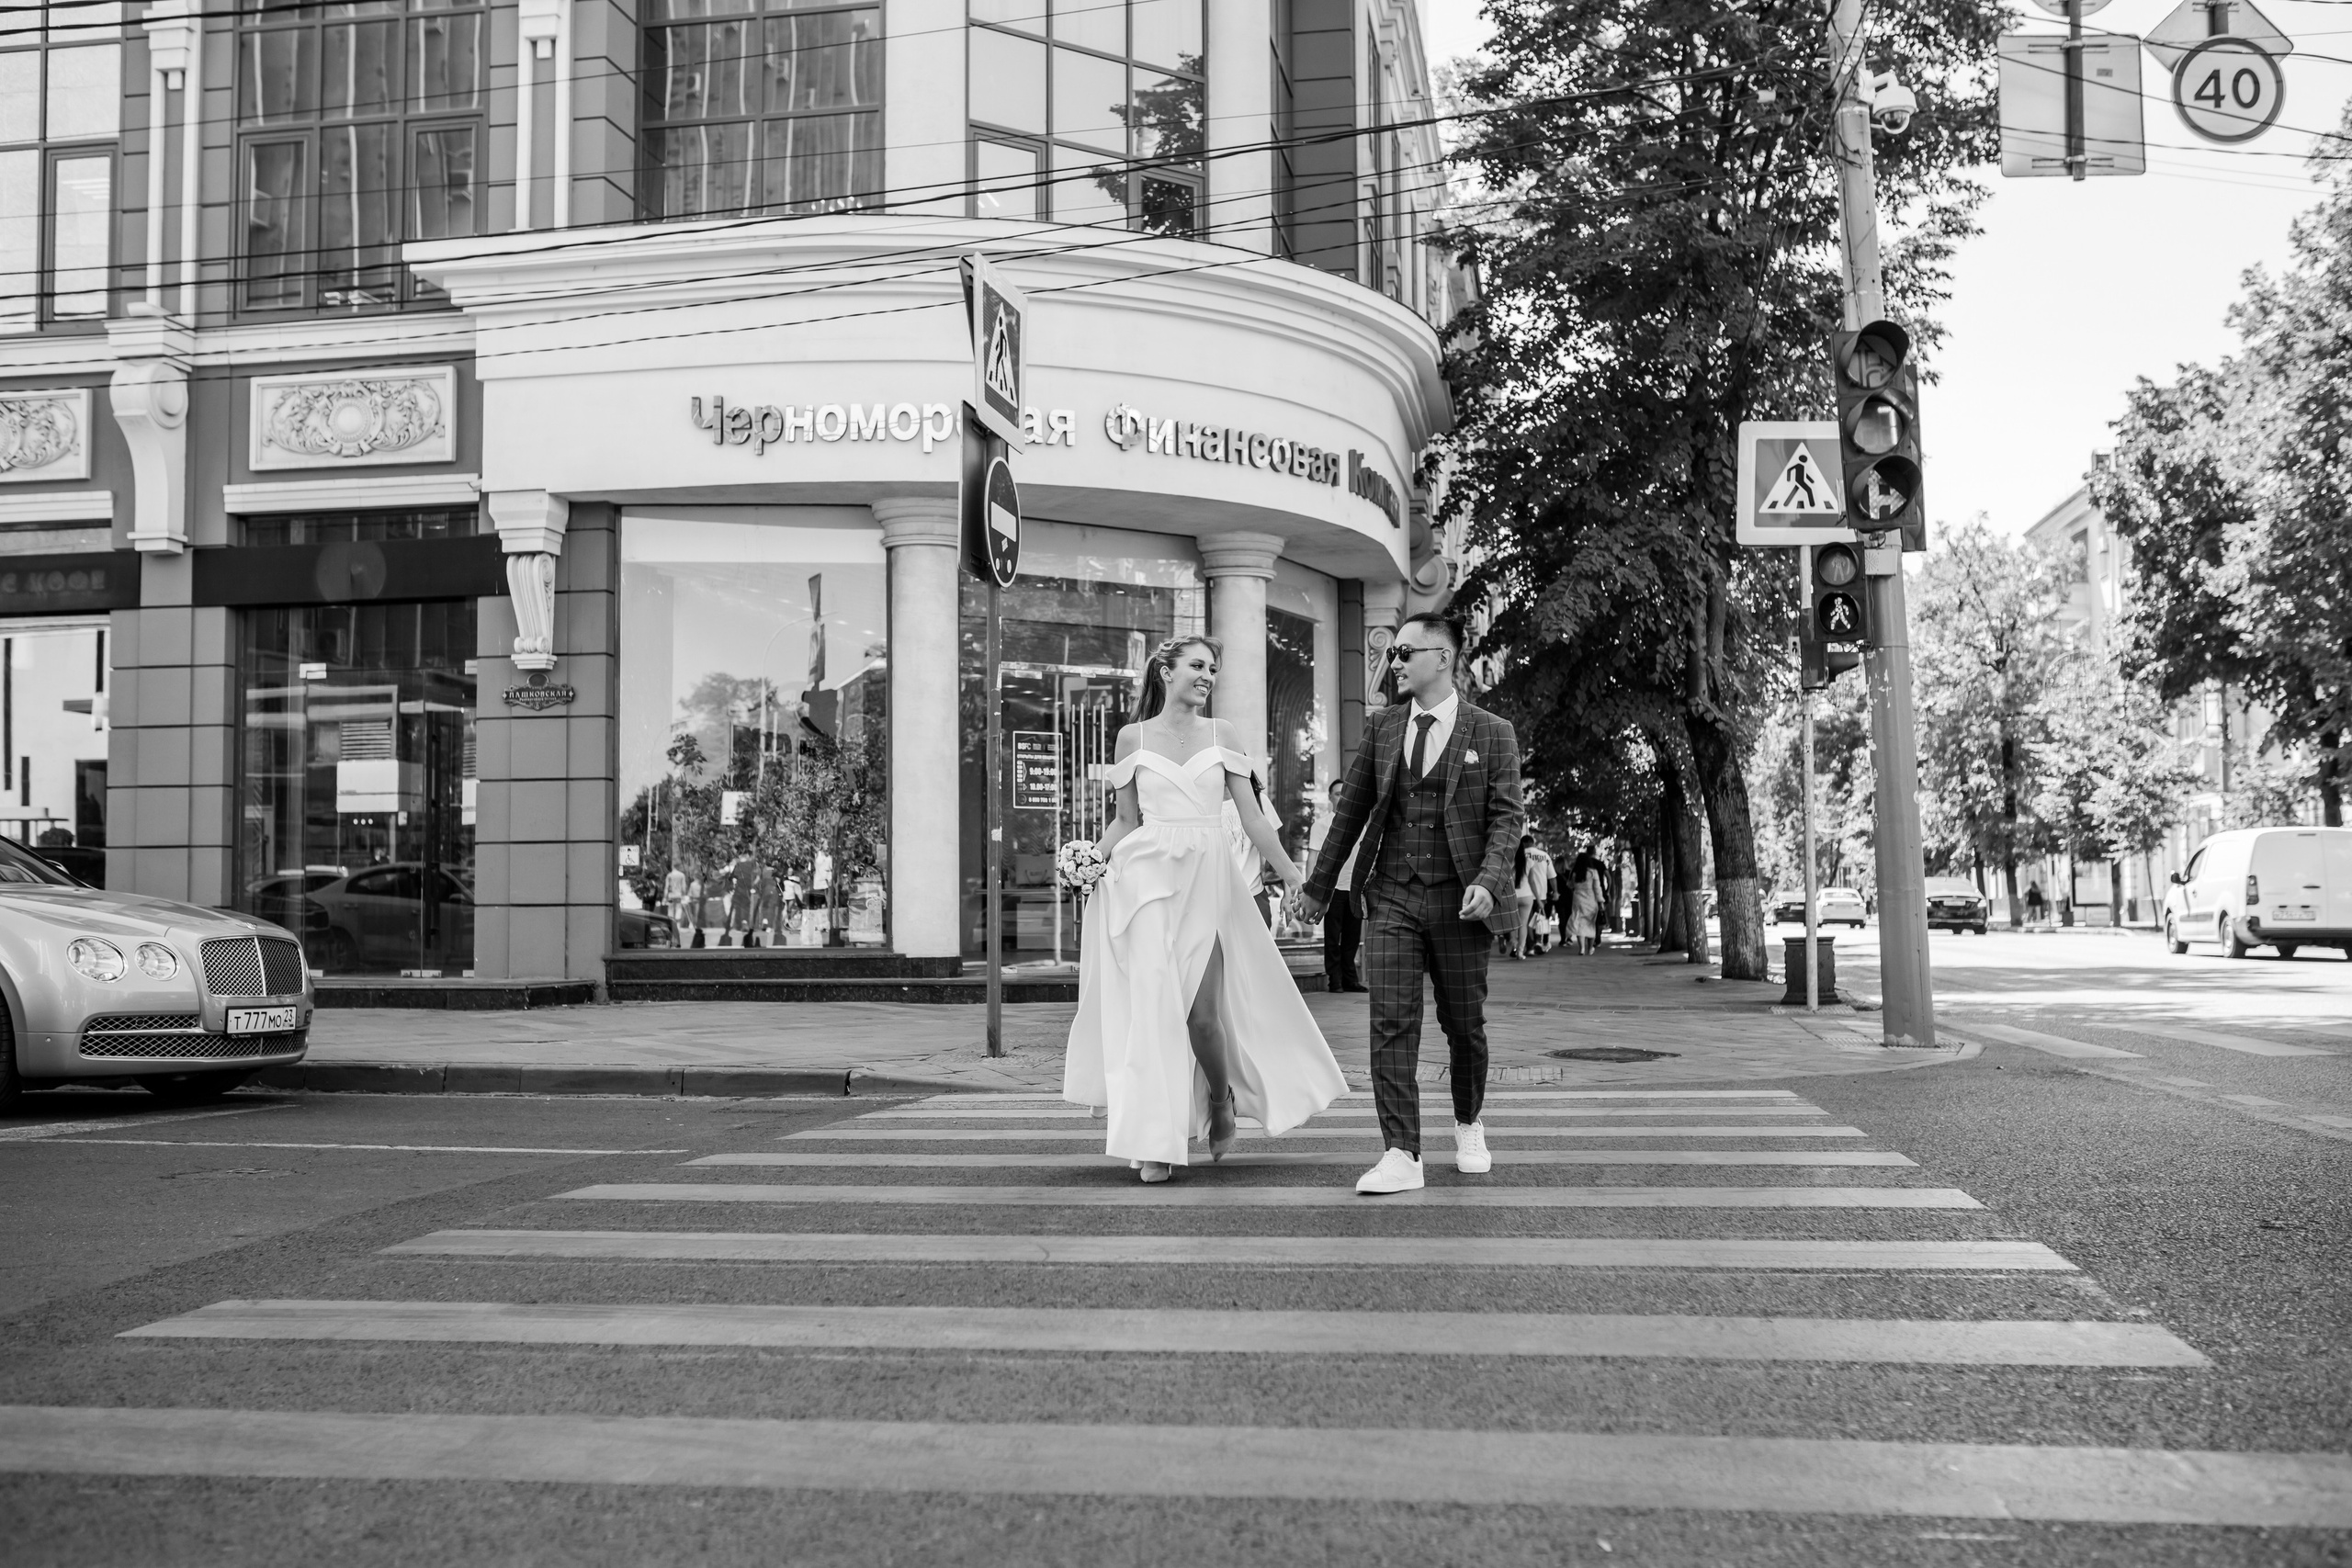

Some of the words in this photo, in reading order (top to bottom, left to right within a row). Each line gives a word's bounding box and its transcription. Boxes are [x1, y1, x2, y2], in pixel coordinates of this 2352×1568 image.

[2193, 67, 2261, 109] 40
[691, 395, 1076, 455] Черноморая
[1104, 402, 1340, 487] Финансовая
[284, 1009, 293, 1022] 23
